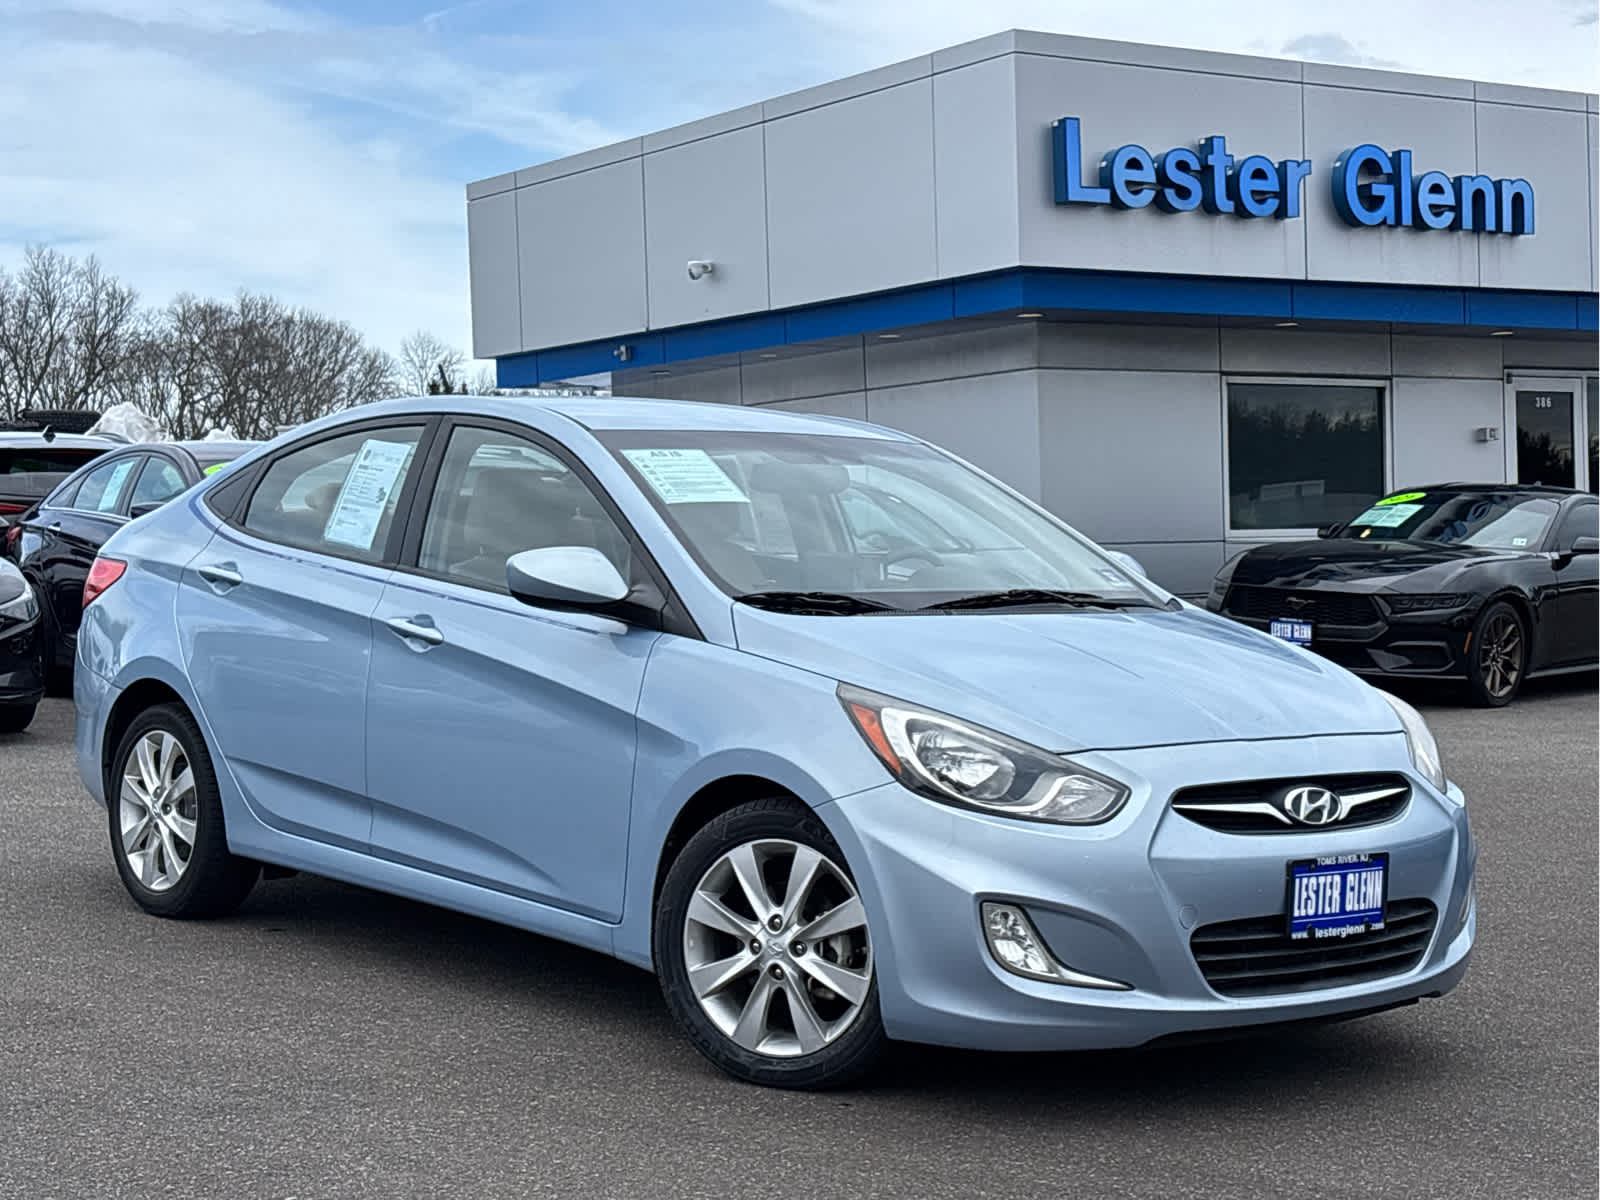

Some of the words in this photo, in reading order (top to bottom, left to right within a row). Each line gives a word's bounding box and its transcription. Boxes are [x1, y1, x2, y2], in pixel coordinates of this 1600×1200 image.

[1052, 117, 1312, 219] Lester
[1332, 143, 1535, 235] Glenn
[1535, 397, 1552, 408] 386
[1293, 874, 1341, 917] LESTER
[1345, 870, 1383, 912] GLENN
[1315, 924, 1365, 938] lesterglenn
